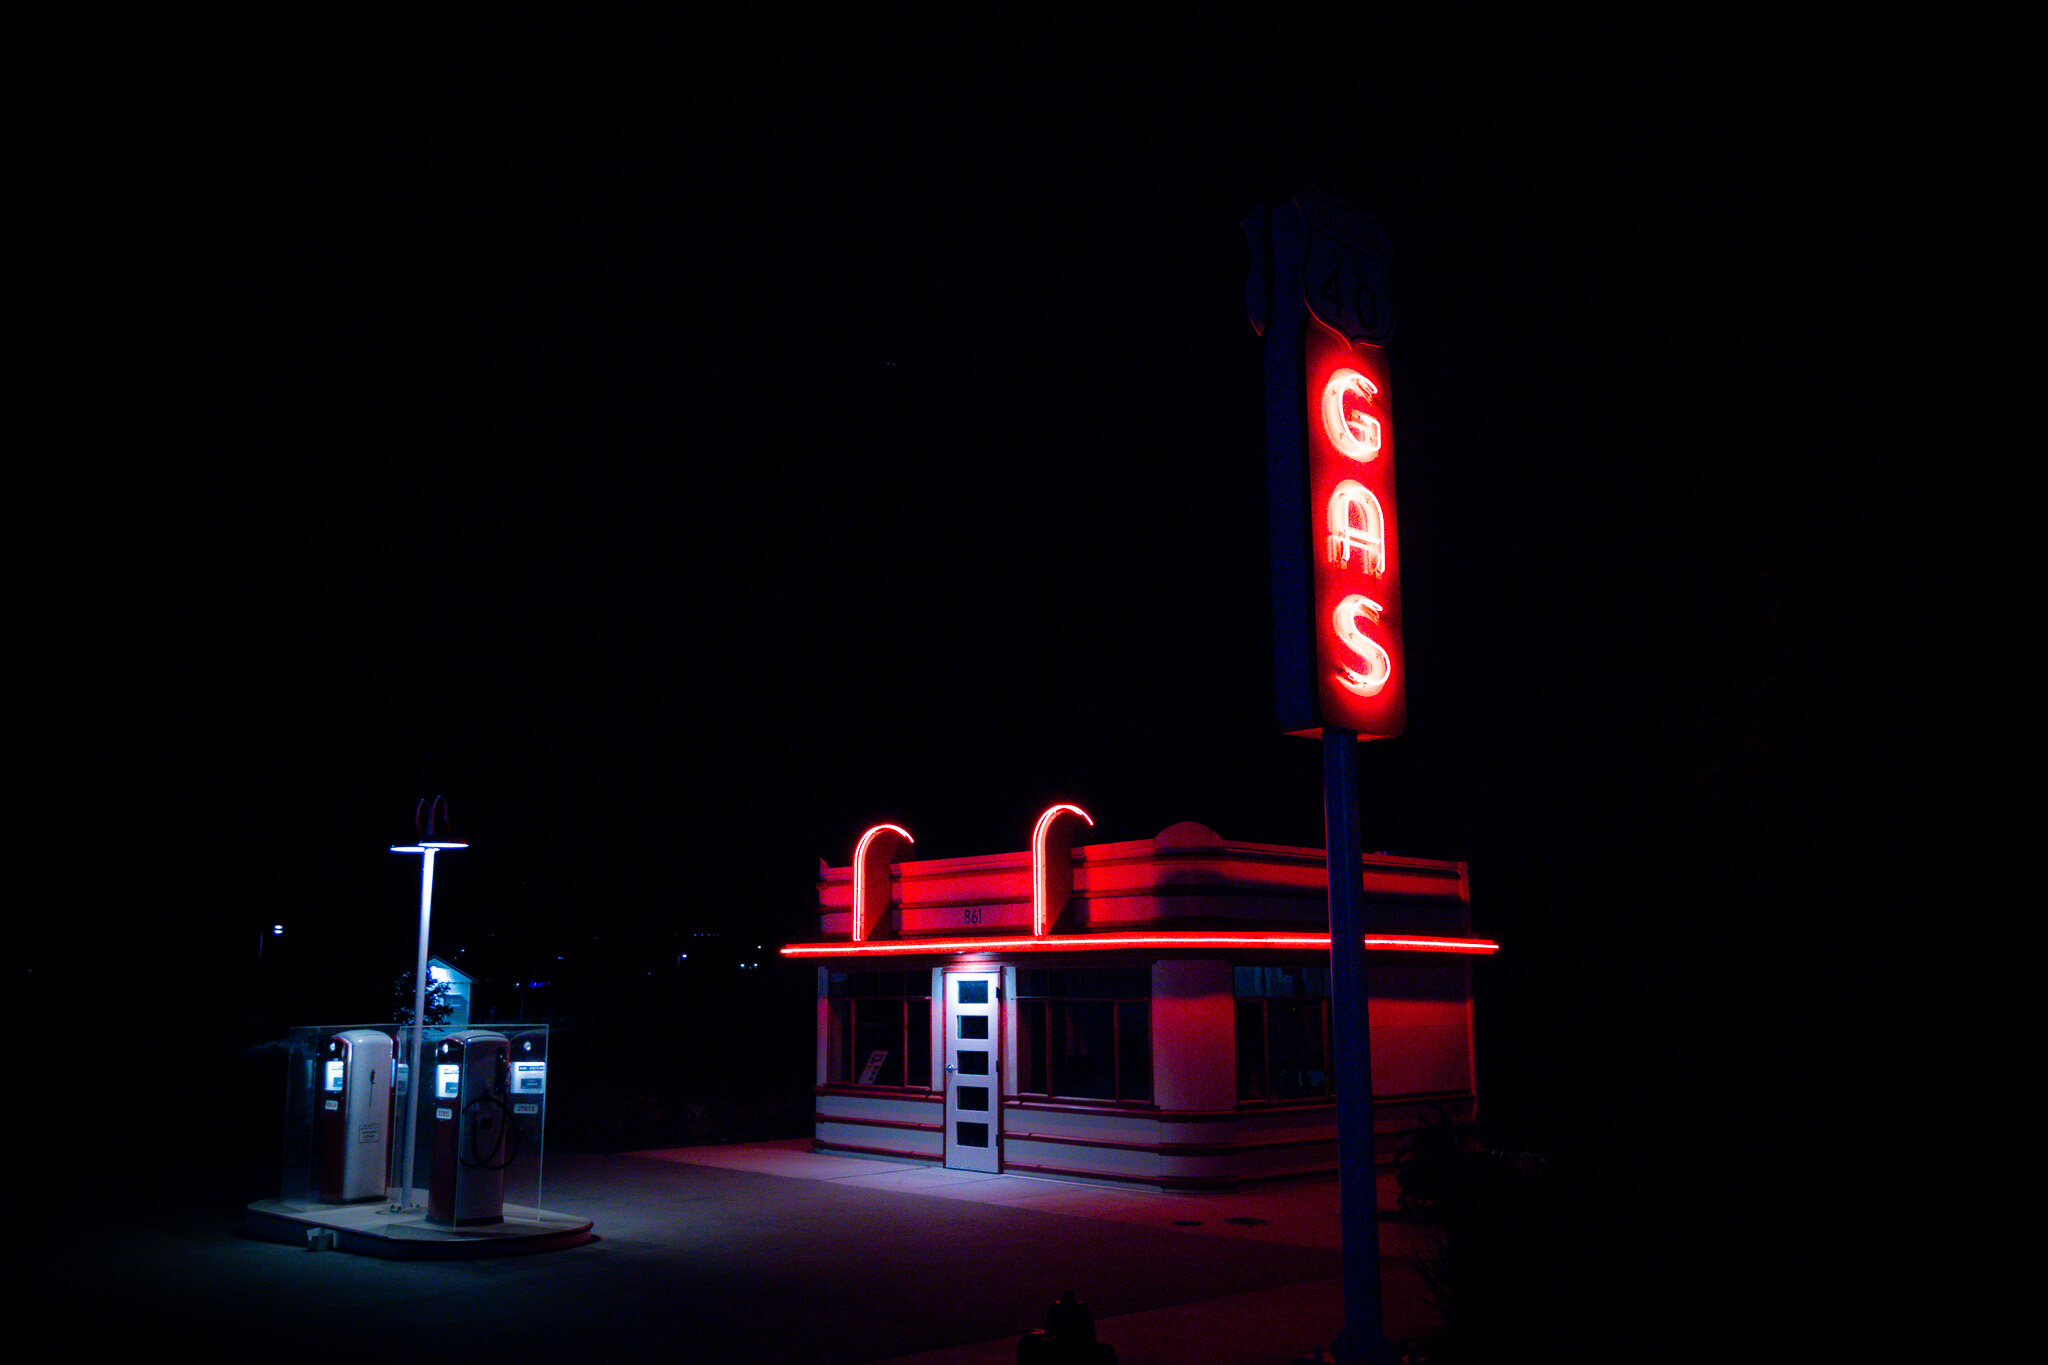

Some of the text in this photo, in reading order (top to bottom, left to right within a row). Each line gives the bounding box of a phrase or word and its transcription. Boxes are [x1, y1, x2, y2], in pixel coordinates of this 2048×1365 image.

[1321, 268, 1378, 330] 40
[1322, 368, 1391, 697] GAS
[964, 908, 982, 924] 861
